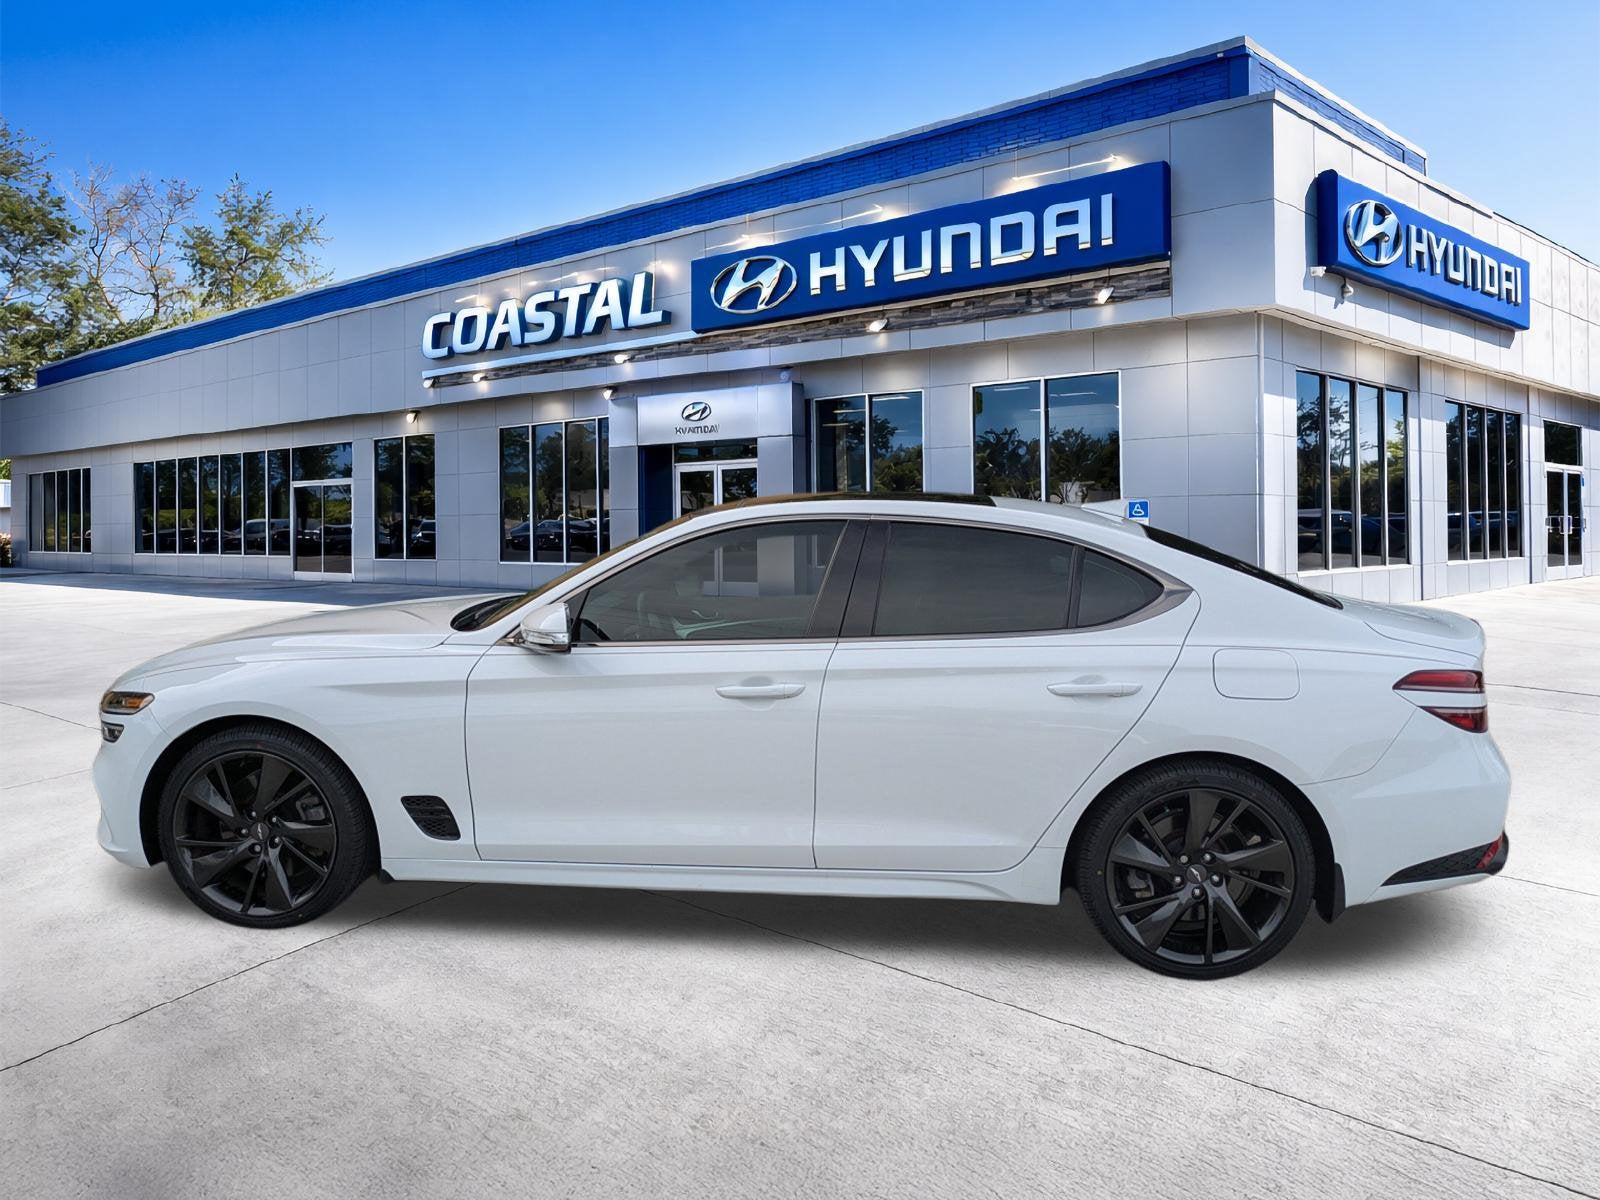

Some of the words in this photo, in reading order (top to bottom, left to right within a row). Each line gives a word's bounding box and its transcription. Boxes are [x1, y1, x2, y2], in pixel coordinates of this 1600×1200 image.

[422, 271, 669, 359] COASTAL
[809, 193, 1113, 295] HYUNDAI
[1406, 224, 1522, 306] HYUNDAI
